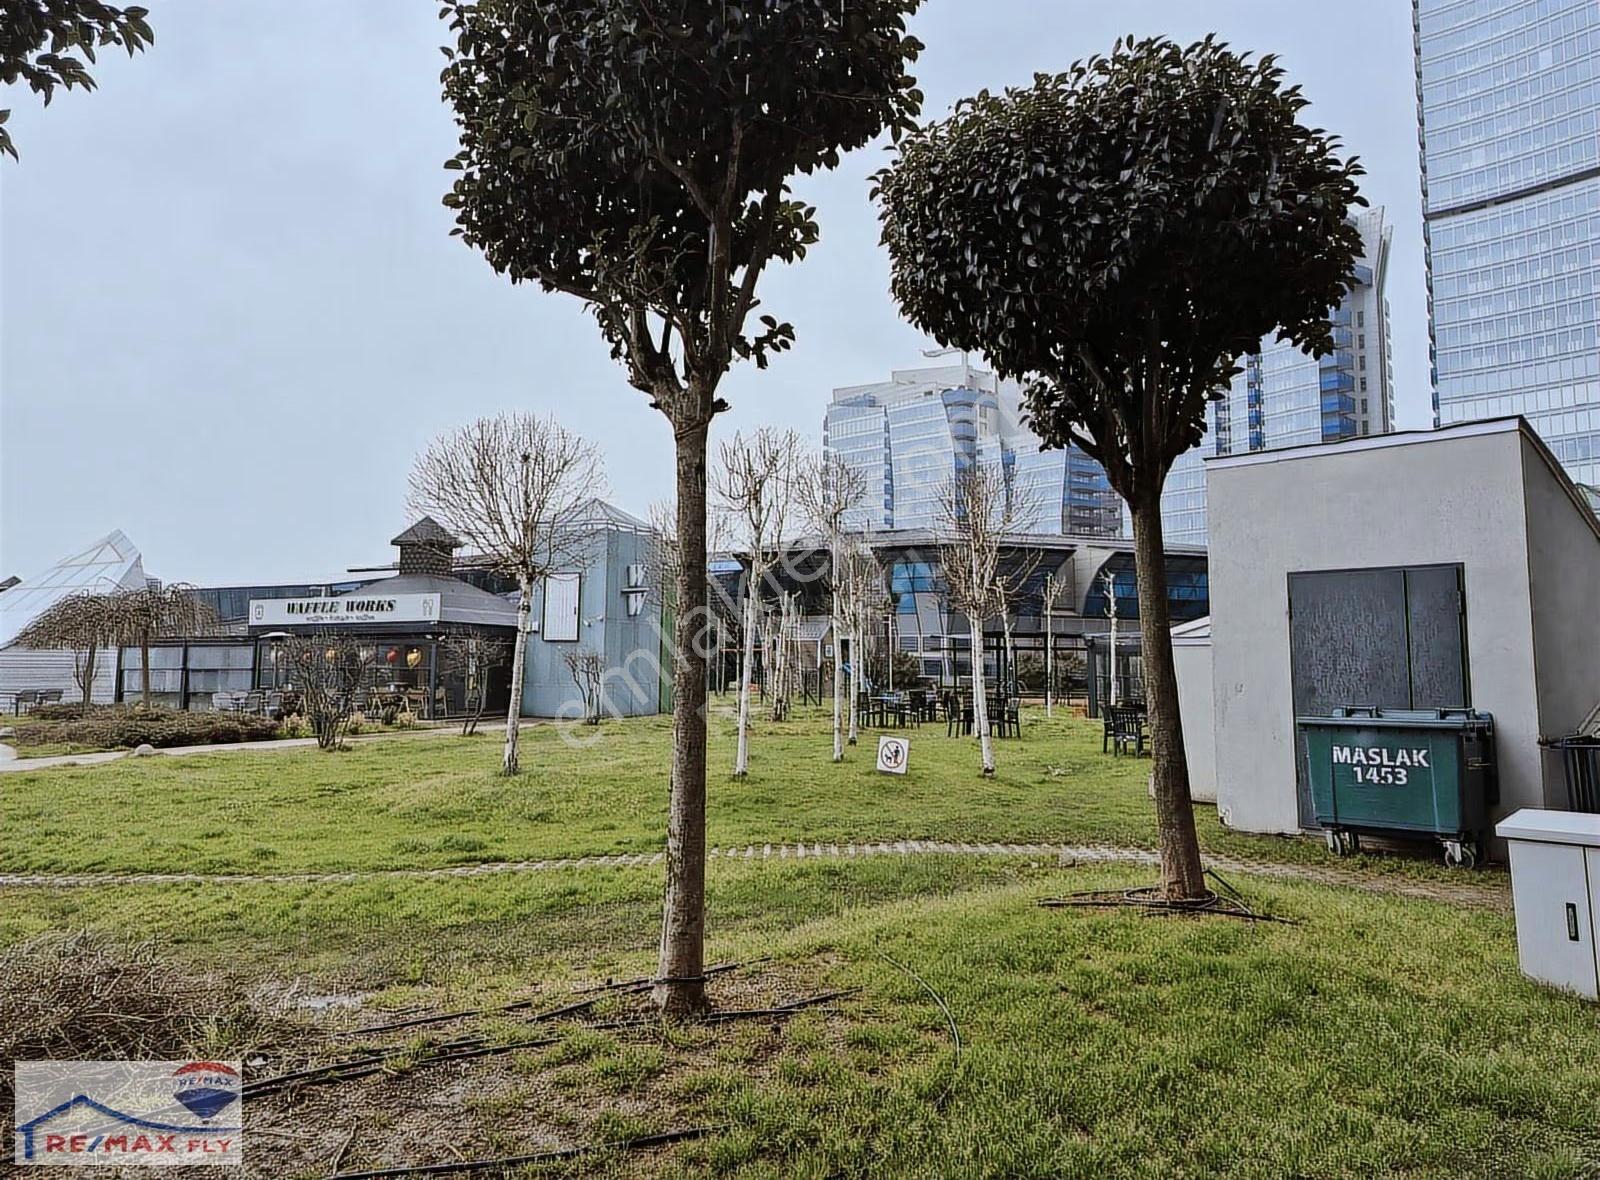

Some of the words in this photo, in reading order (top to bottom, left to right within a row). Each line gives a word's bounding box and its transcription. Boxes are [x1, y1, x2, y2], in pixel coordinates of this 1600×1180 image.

[287, 601, 339, 614] WAFFLE
[345, 599, 396, 612] WORKS
[1332, 745, 1429, 767] MASLAK
[1353, 766, 1408, 785] 1453
